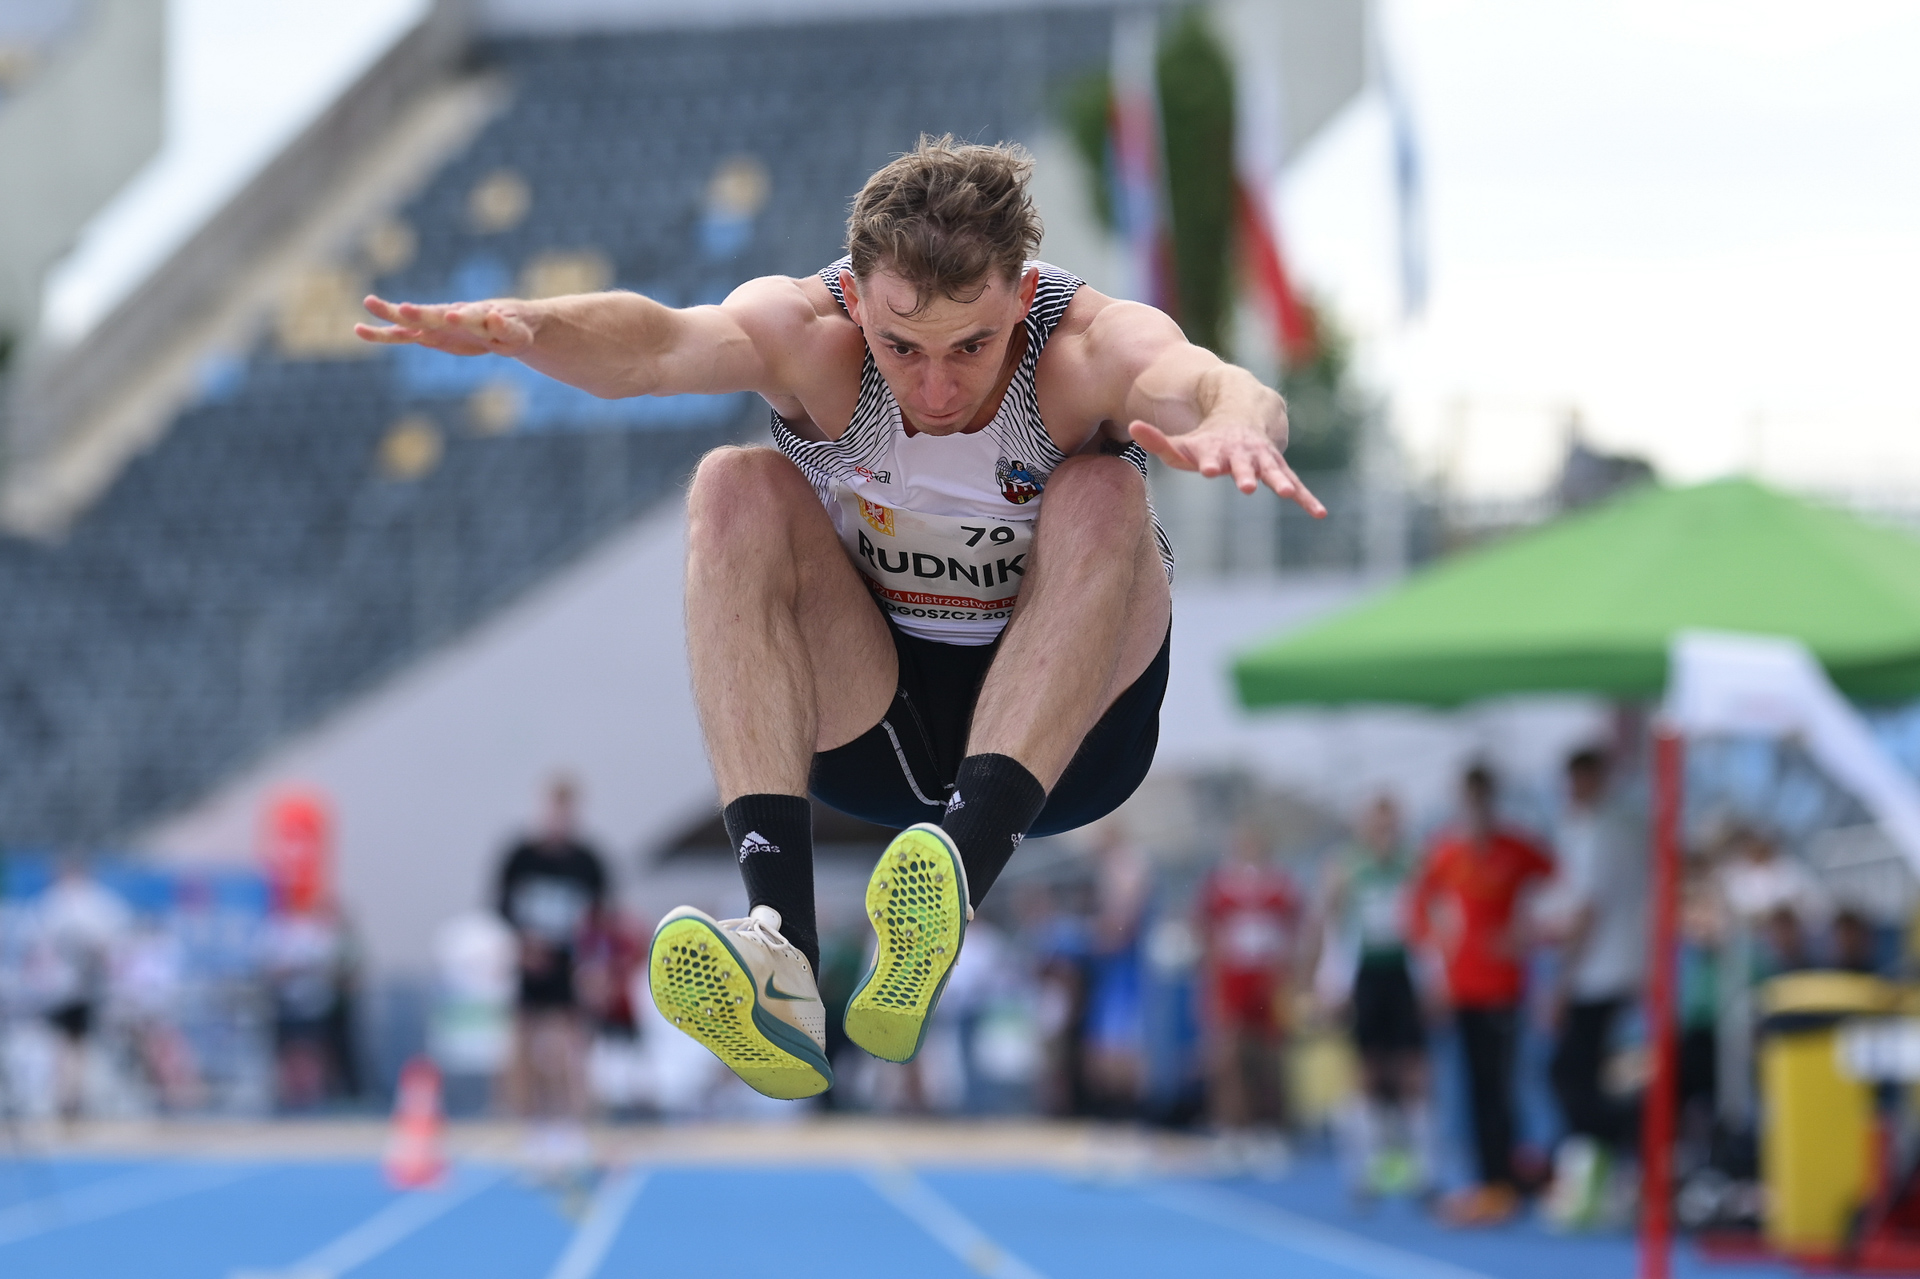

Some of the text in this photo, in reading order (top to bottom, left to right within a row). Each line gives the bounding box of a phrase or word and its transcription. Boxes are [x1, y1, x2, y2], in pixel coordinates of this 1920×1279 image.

[960, 526, 1015, 548] 79
[858, 529, 1026, 588] RUDNIK
[873, 582, 903, 601] PZLA
[907, 593, 997, 610] Mistrzostwa
[883, 602, 978, 621] DGOSZCZ
